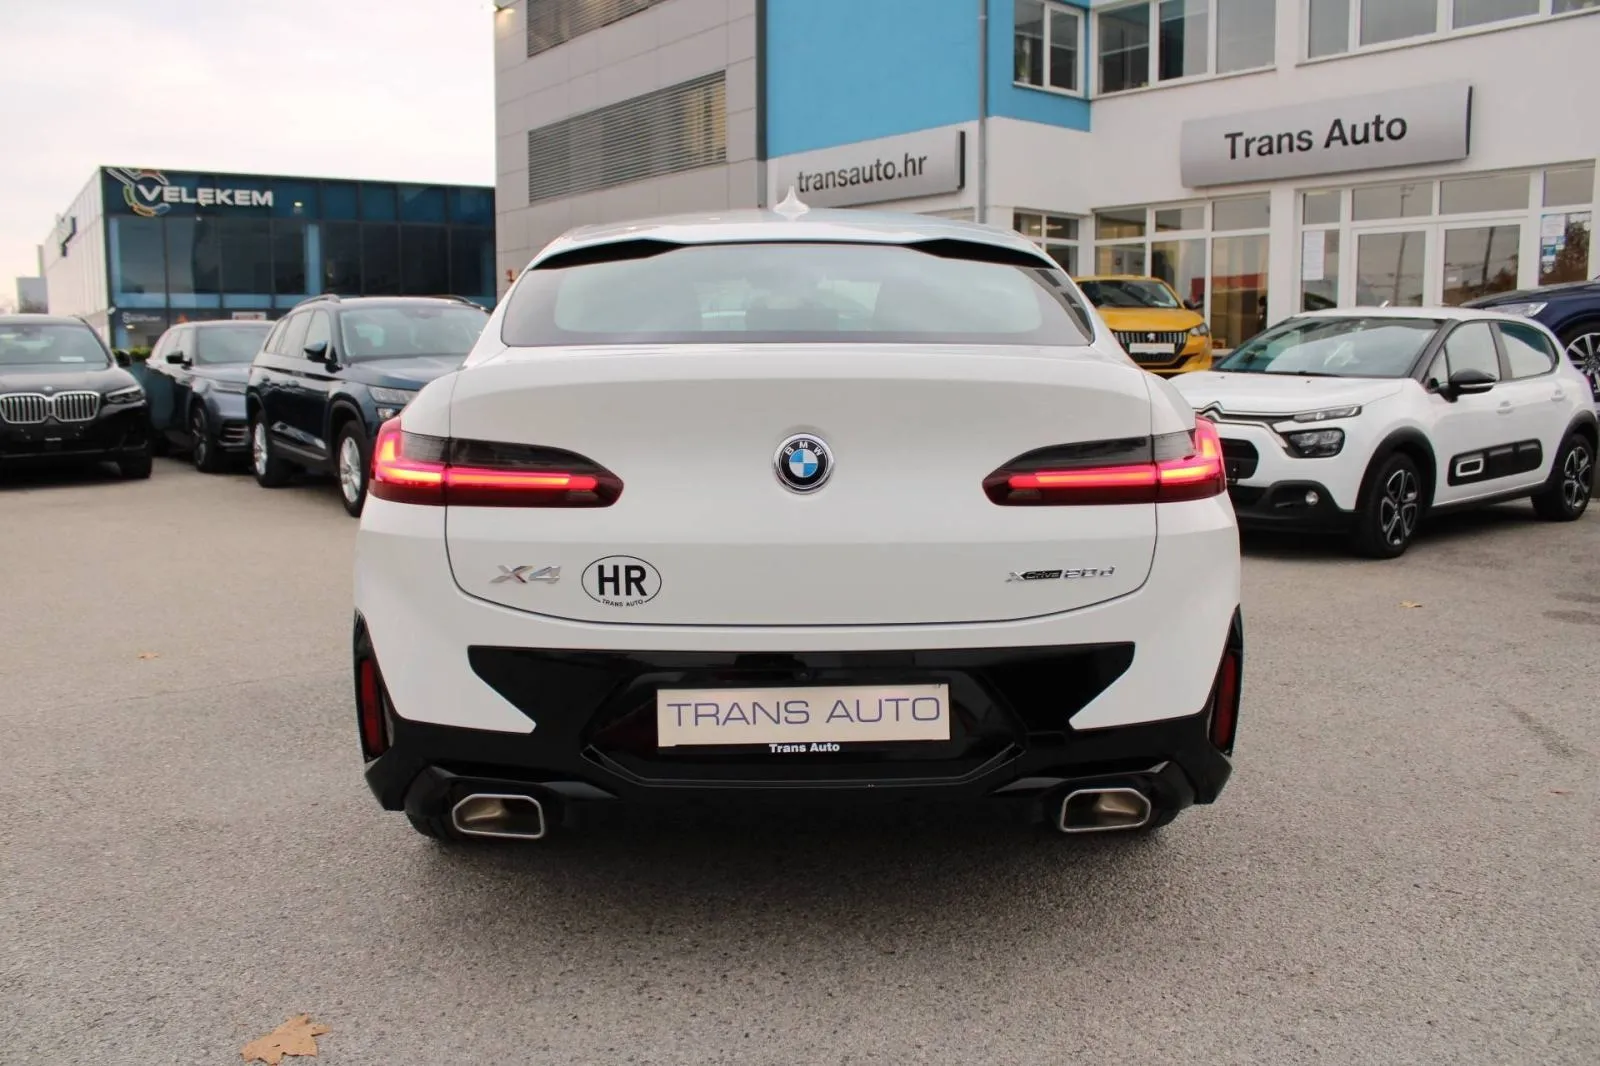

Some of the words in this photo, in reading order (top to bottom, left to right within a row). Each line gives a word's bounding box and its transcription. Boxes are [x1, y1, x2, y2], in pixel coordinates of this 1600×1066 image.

[1224, 129, 1314, 160] Trans
[1323, 114, 1407, 149] Auto
[797, 152, 927, 193] transauto.hr
[137, 184, 274, 207] VELEKEM
[784, 441, 823, 457] BMW
[489, 564, 562, 585] X4
[598, 564, 648, 596] HR
[602, 598, 623, 607] TRANS
[626, 599, 644, 607] AUTO
[666, 700, 811, 727] TRANS
[825, 697, 941, 724] AUTO
[768, 743, 807, 753] Trans
[809, 742, 840, 752] Auto
